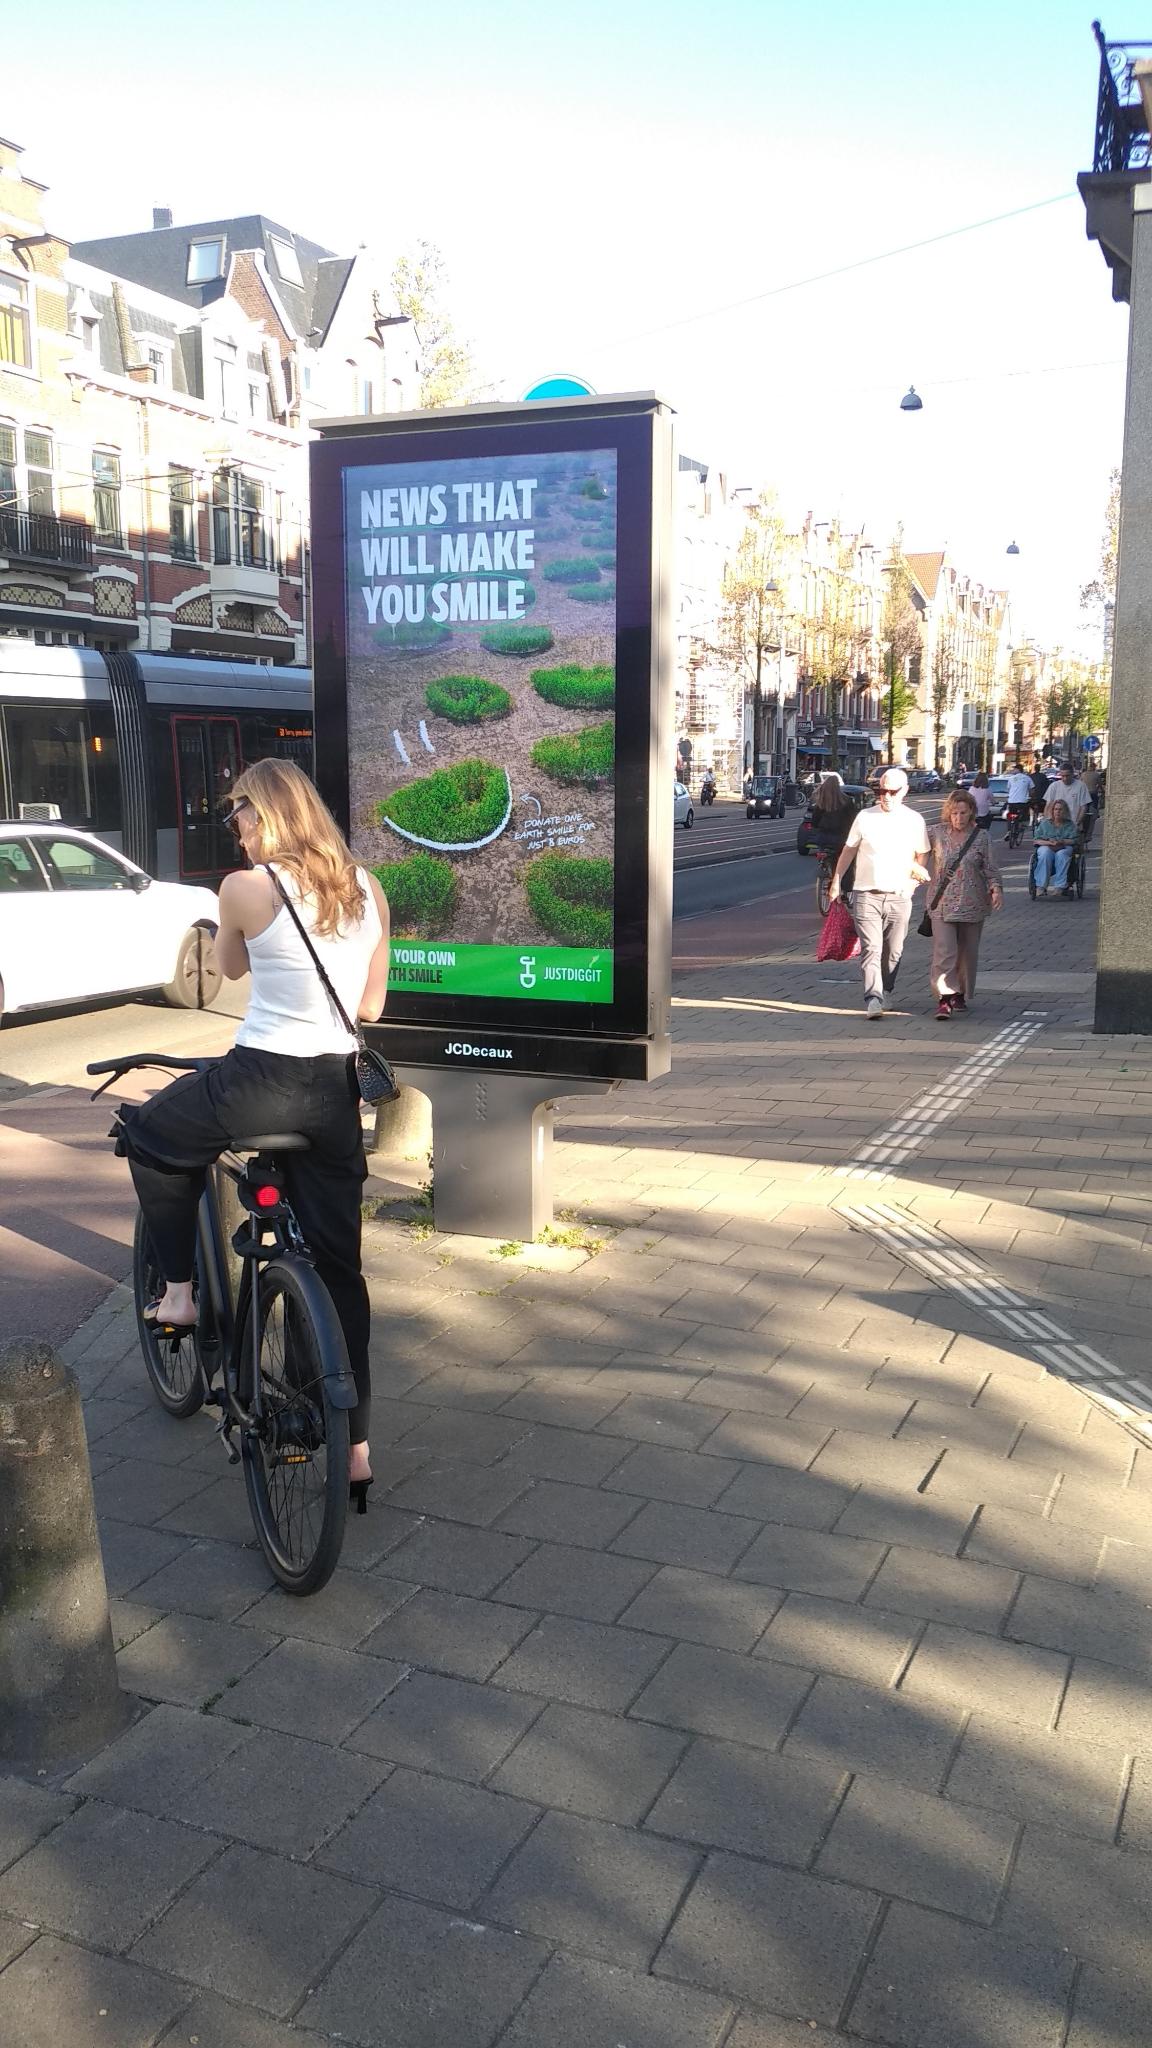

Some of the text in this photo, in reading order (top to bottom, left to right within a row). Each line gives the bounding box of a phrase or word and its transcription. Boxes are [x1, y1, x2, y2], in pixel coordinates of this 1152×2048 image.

[361, 479, 538, 528] NEWS THAT
[360, 529, 535, 576] WILL MAKE
[361, 580, 526, 624] YOU SMILE
[524, 813, 583, 828] DONATE ONE
[514, 822, 596, 840] EARTH SMILE FOR
[527, 836, 586, 850] JUST 8 EUROS
[393, 948, 456, 966] YOUR OWN
[408, 968, 443, 984] SMILE
[543, 966, 602, 982] JUSTDIGGIT
[444, 1042, 513, 1059] JCDecaux
